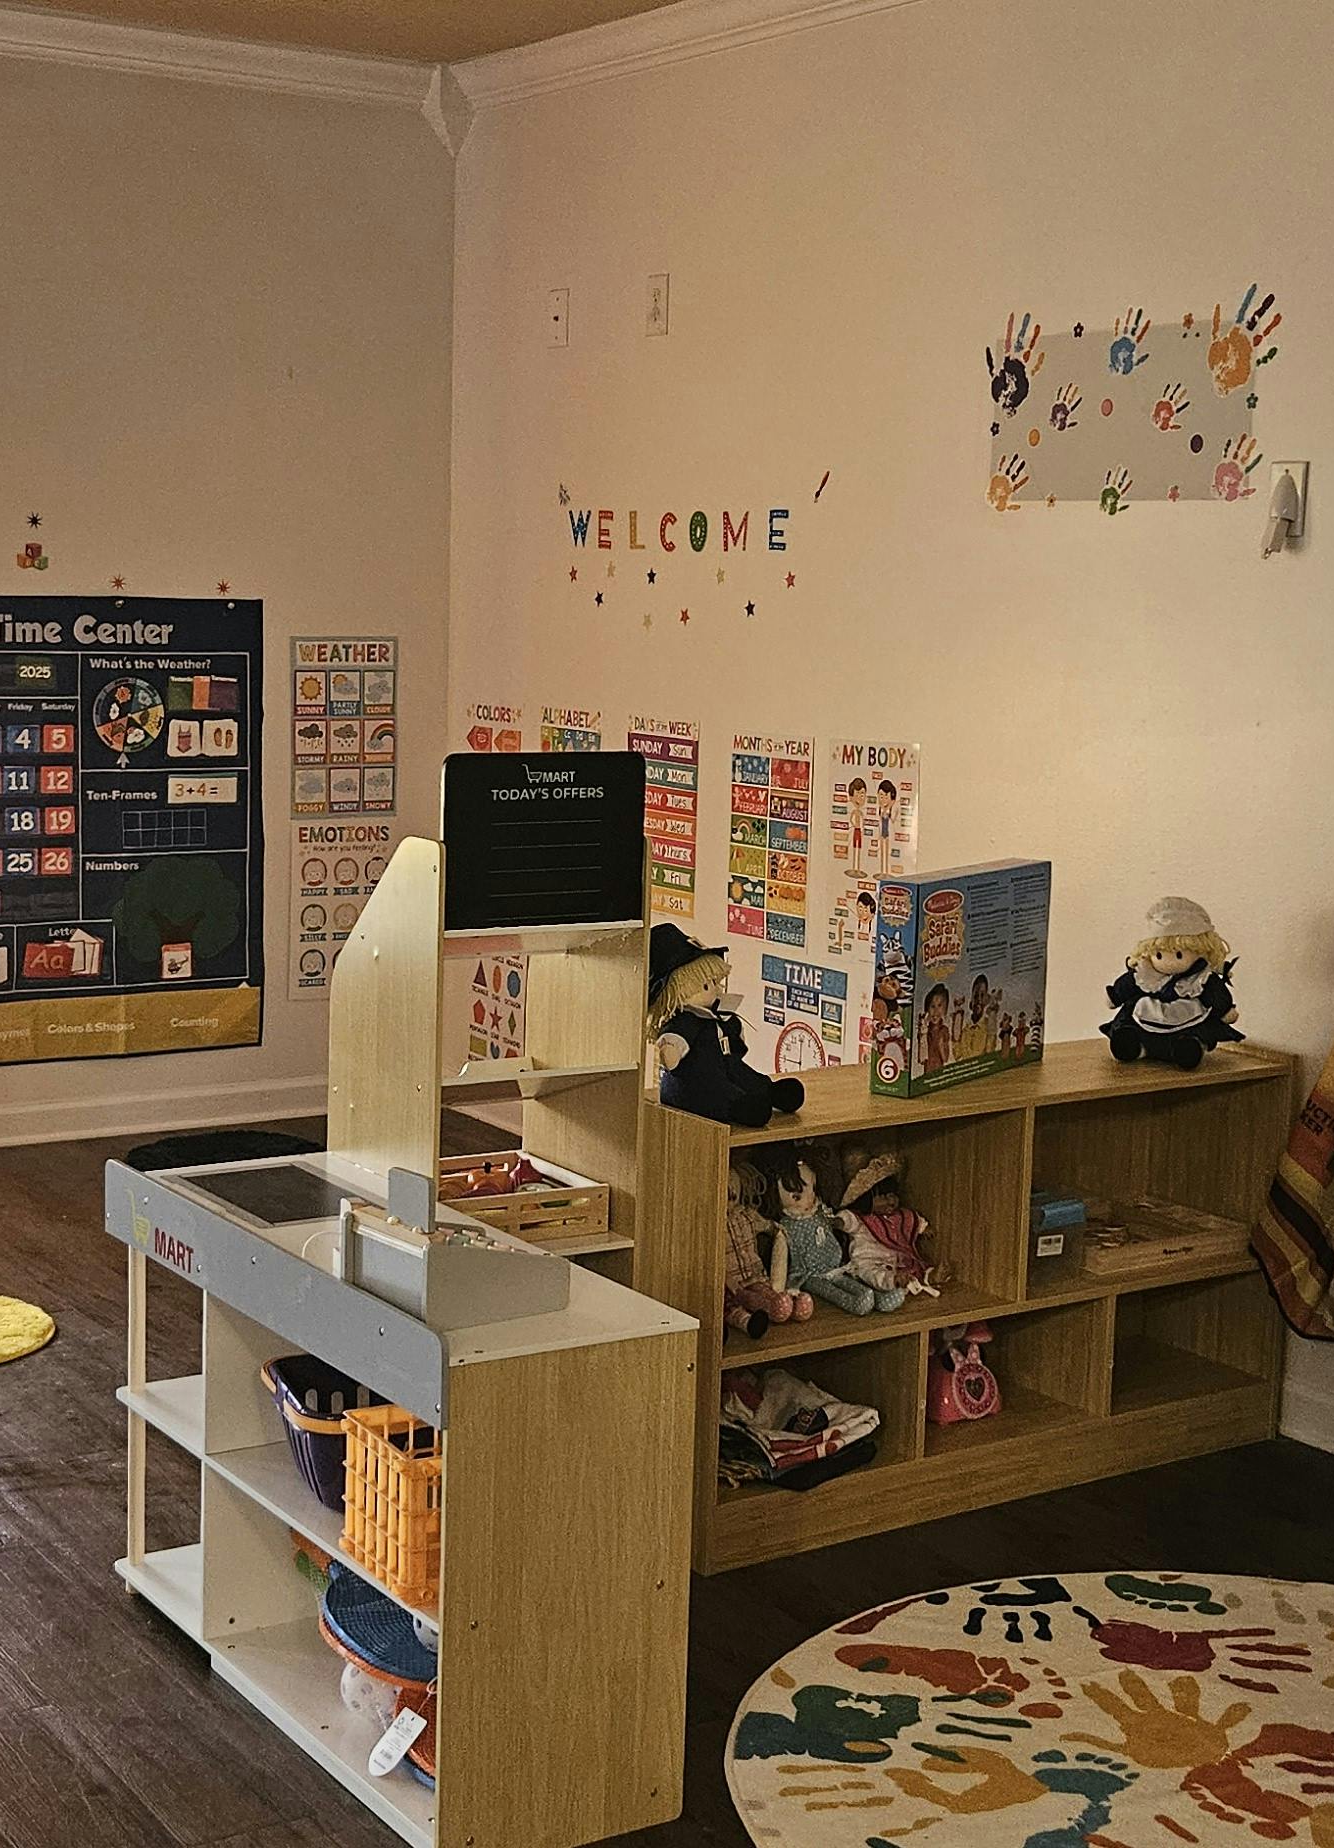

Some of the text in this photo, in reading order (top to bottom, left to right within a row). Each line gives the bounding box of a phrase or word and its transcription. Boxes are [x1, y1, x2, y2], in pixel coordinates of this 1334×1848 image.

[568, 509, 789, 552] WELCOME
[73, 614, 174, 646] Center
[299, 643, 390, 663] WEATHER
[89, 657, 211, 669] What's the Weather?
[18, 665, 52, 679] 2025
[7, 703, 33, 713] Friday
[41, 702, 76, 712] Saturday
[477, 704, 511, 723] COLORS
[542, 707, 591, 728] ALPHABET
[634, 716, 692, 736] DAYS WEEK
[14, 728, 31, 749] 4
[51, 727, 67, 749] 5
[632, 738, 663, 755] SUNDAY
[733, 735, 810, 756] MONTHS YEAR
[673, 744, 687, 756] Sun
[841, 744, 906, 768] MY BODY
[7, 772, 29, 790] 11
[46, 771, 69, 790] 12
[542, 771, 576, 783] MART
[671, 770, 687, 782] Mon
[86, 790, 158, 800] Ten-Frames
[491, 787, 604, 801] TODAY'S OFFERS
[671, 796, 687, 808] Tues
[9, 811, 35, 832] 18
[49, 810, 72, 831] 19
[781, 808, 807, 820] AUGUST
[299, 826, 390, 843] EMOTIONS
[670, 822, 685, 834] Wed
[771, 837, 807, 852] SEPTEMBER
[7, 853, 33, 872] 25
[43, 852, 69, 871] 26
[85, 861, 139, 871] Numbers
[669, 897, 683, 910] Sat
[929, 912, 958, 939] Safari
[923, 937, 961, 963] Buddies
[29, 950, 65, 969] Aa
[785, 963, 823, 990] TIME
[47, 1024, 84, 1034] Colors
[169, 1016, 219, 1028] Counting
[883, 1064, 895, 1077] 6
[154, 1227, 195, 1274] MART
